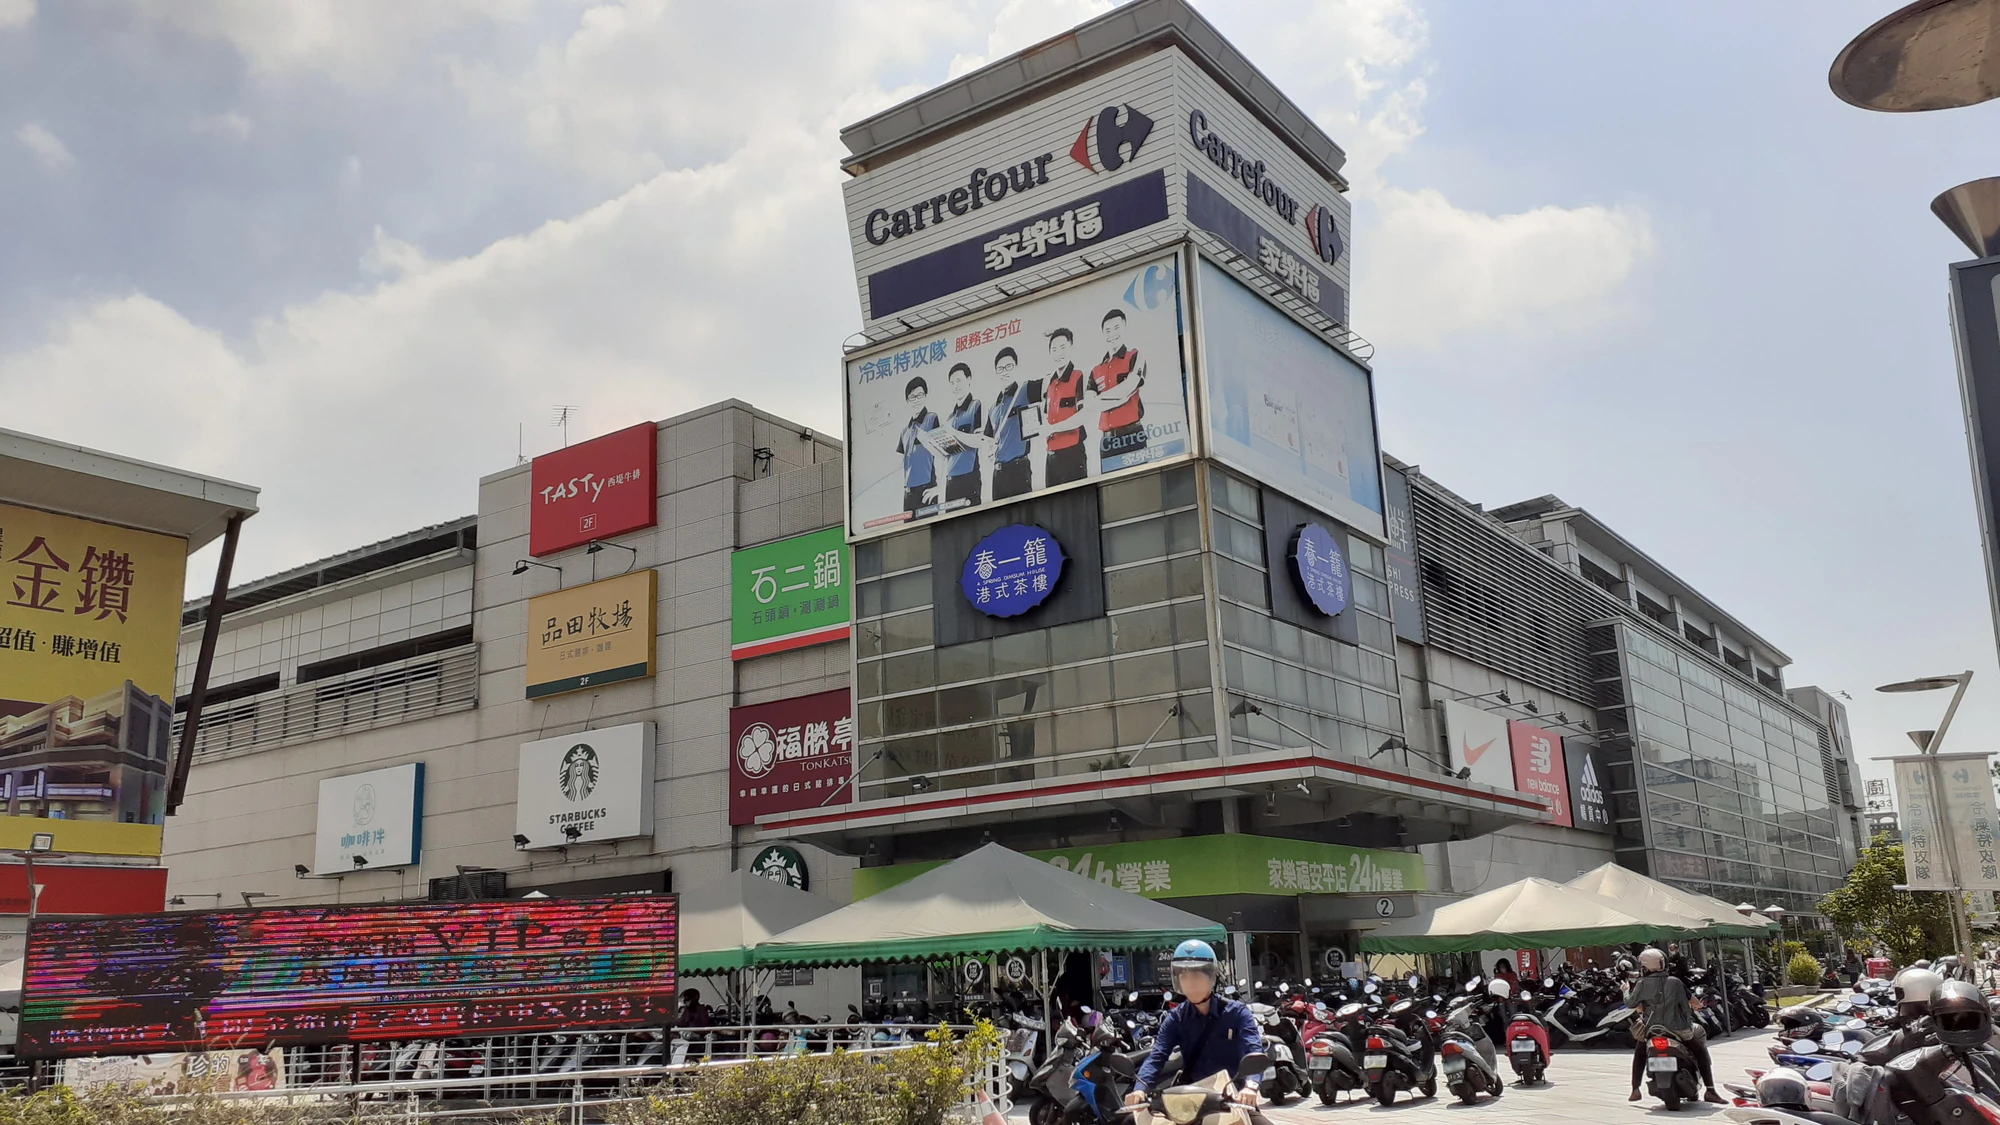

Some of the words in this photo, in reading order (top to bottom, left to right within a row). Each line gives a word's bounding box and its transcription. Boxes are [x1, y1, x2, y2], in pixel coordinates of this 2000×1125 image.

[1189, 109, 1300, 227] Carrefour
[865, 153, 1053, 246] Carrefour
[983, 201, 1103, 271] 家樂福
[1257, 235, 1321, 303] 家樂福
[858, 338, 948, 386] 冷氣特攻隊
[954, 318, 1022, 353] 服務全方位
[1100, 420, 1181, 452] Carrefour
[583, 517, 593, 529] 2F
[750, 549, 841, 604] 石二鍋
[974, 536, 1048, 579] 春一籠
[982, 576, 1002, 586] SPRING
[1003, 571, 1025, 583] DIMSUM
[1027, 566, 1046, 576] HOUSE
[6, 535, 135, 625] 金鑽
[975, 574, 1048, 604] 港式茶樓
[541, 599, 633, 646] 品田牧場
[580, 676, 590, 686] 2F
[775, 716, 852, 760] 福勝亭
[1526, 777, 1539, 791] new
[1538, 778, 1560, 796] balance
[1580, 784, 1604, 805] adidas
[549, 808, 607, 825] STARBUCKS
[1381, 899, 1389, 915] 2
